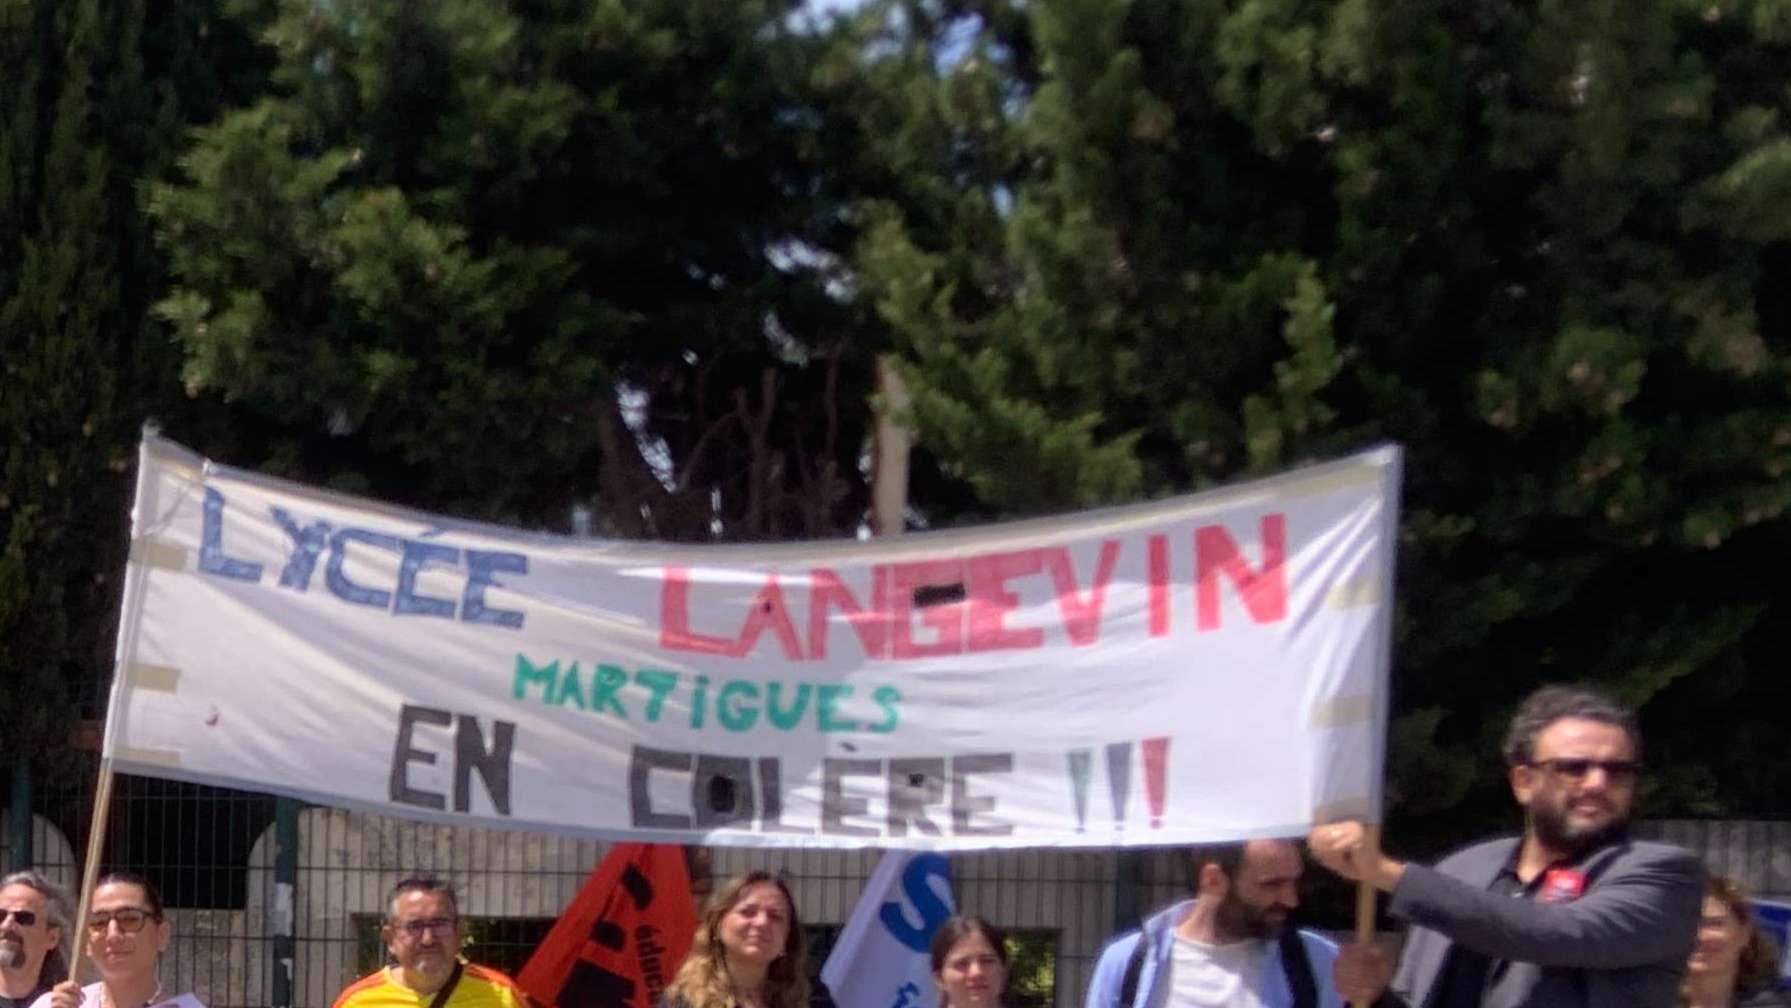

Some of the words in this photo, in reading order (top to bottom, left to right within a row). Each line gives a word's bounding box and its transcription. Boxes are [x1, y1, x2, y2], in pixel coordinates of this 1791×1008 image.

[198, 486, 528, 629] LYCÉE
[659, 513, 1289, 661] LANGEVIN
[389, 704, 517, 815] EN
[629, 742, 1014, 837] COLÈRE
